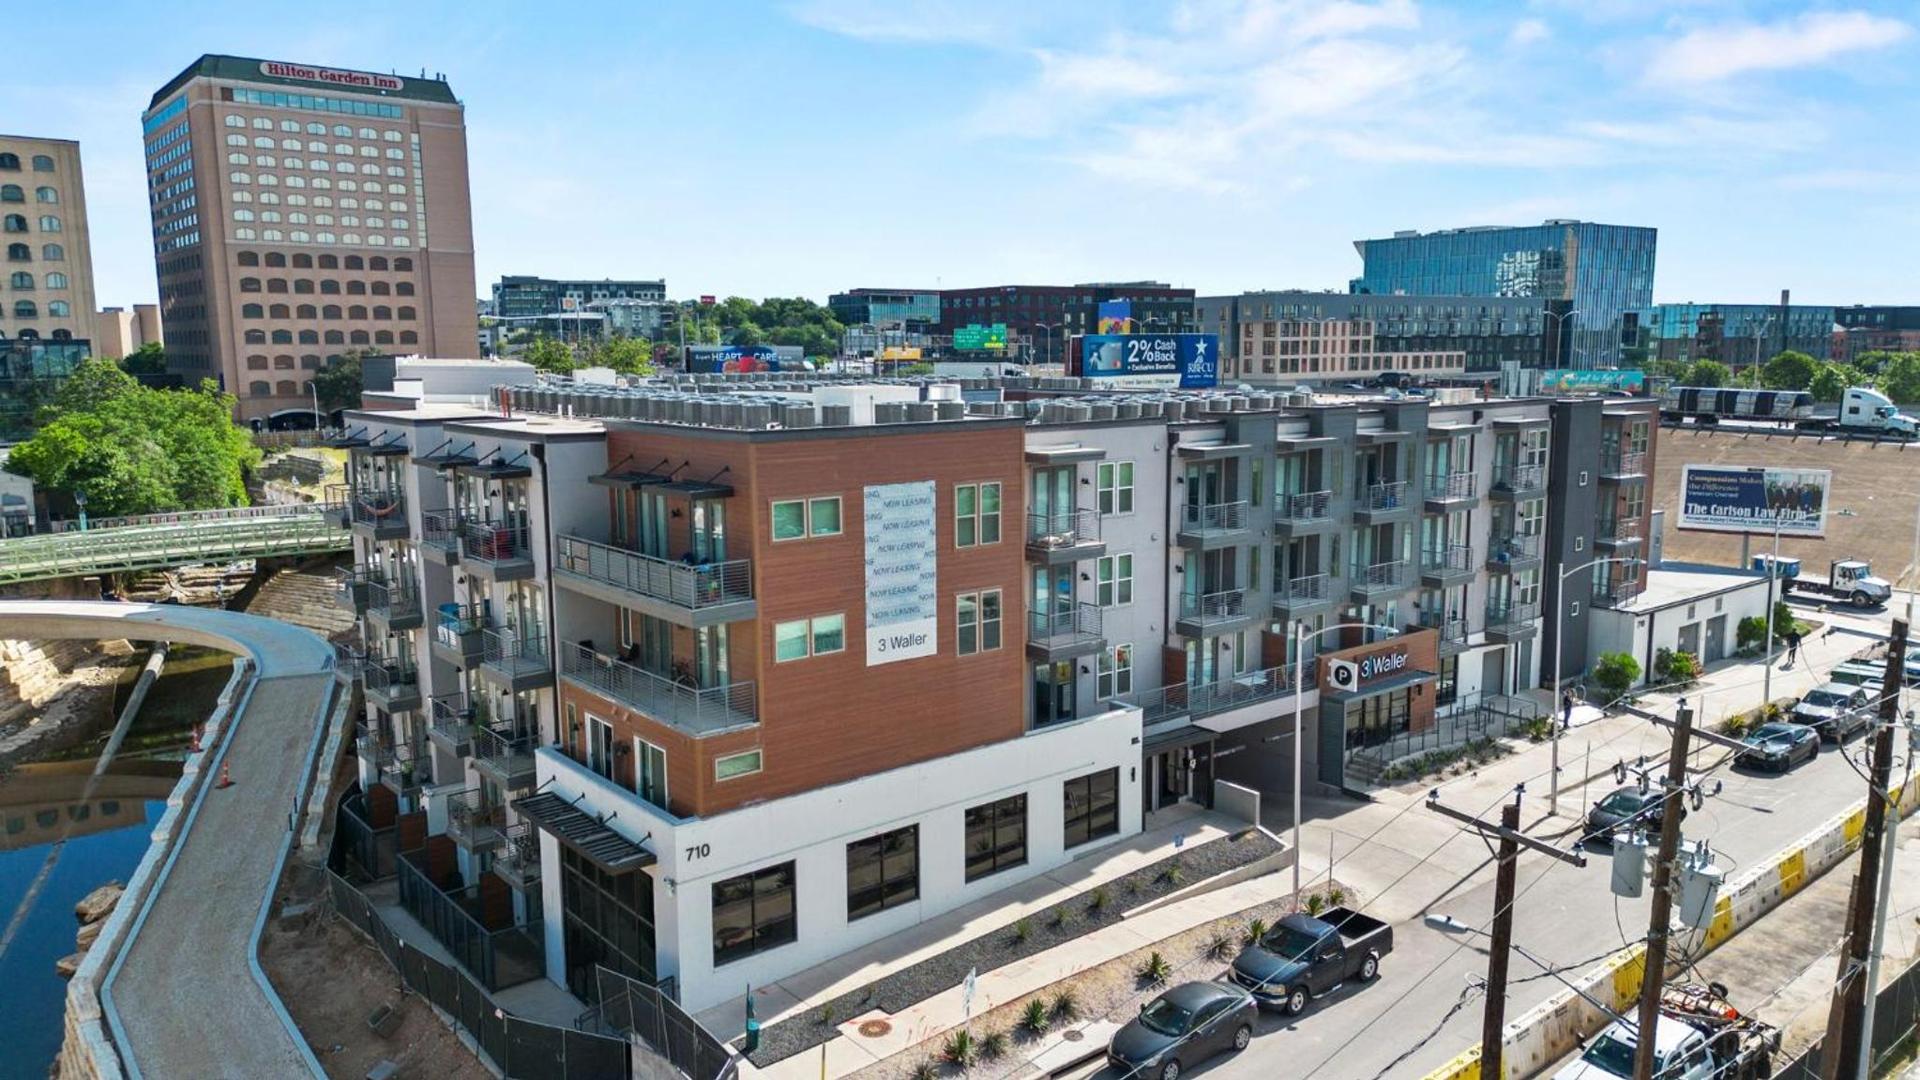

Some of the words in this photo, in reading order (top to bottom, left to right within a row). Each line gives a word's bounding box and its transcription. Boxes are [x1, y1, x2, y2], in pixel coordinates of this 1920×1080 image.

[267, 63, 315, 80] Hilton
[319, 69, 370, 85] Garden
[373, 75, 398, 89] Inn
[711, 352, 742, 361] HEART
[753, 352, 777, 361] CARE
[1127, 340, 1154, 363] 2%
[1154, 339, 1176, 350] Cash
[1154, 350, 1176, 362] Back
[1686, 503, 1707, 515] The
[1710, 504, 1752, 517] Carlson
[1754, 507, 1777, 519] Law
[1779, 507, 1807, 521] Firm
[878, 638, 887, 652] 3
[890, 633, 927, 650] Waller
[1361, 660, 1370, 677] 3
[1373, 653, 1409, 675] Waller
[685, 843, 711, 861] 710
